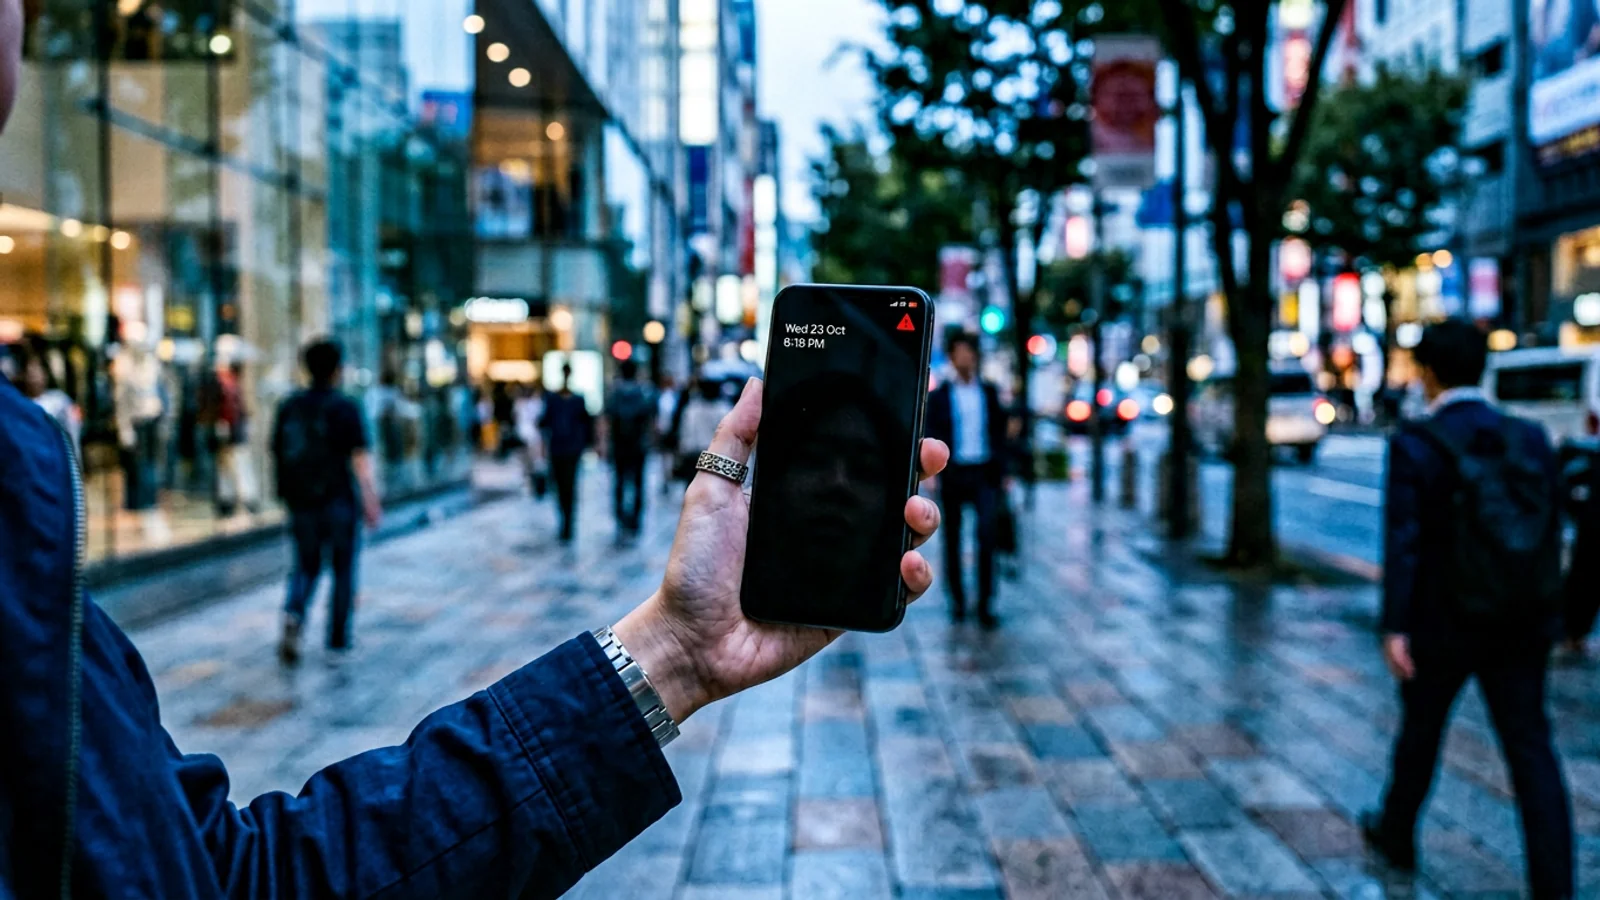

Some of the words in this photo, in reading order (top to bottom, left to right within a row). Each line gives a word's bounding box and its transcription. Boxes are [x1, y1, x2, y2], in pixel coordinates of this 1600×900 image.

[785, 323, 808, 334] Wed
[810, 324, 824, 335] 23
[826, 324, 846, 335] Oct
[783, 337, 806, 348] 8:18
[808, 338, 825, 349] PM
